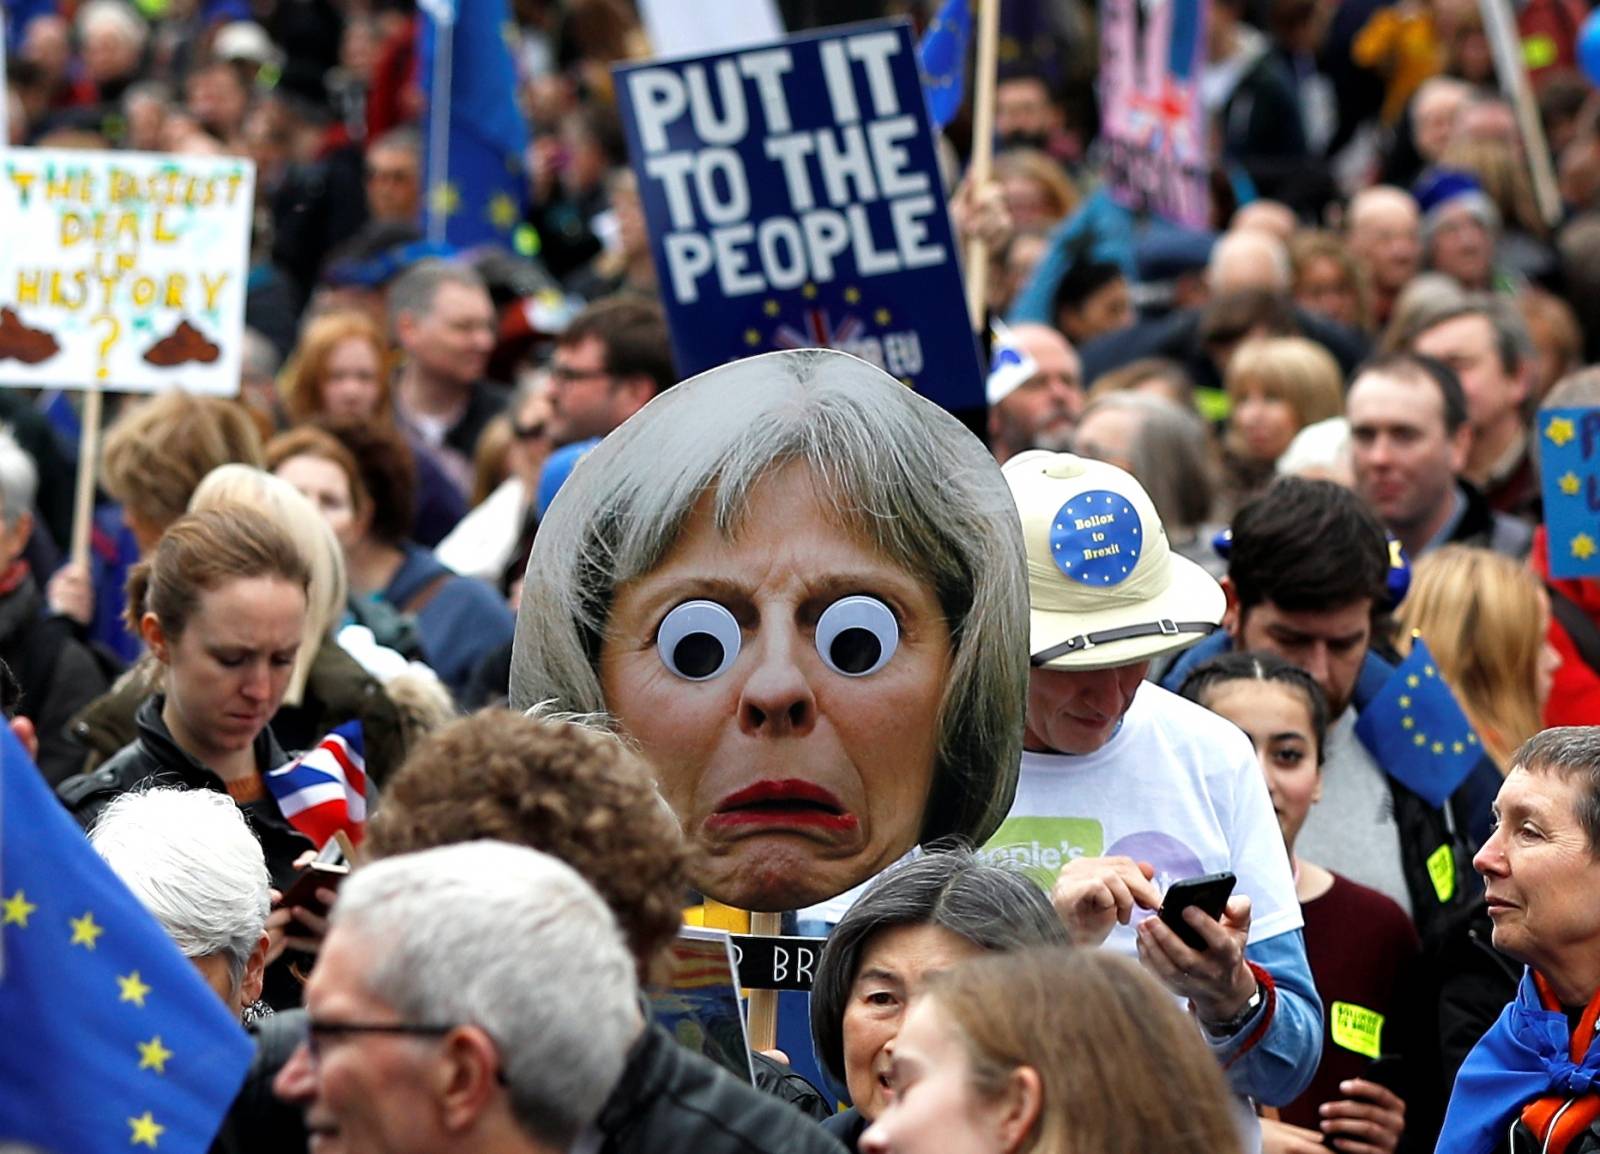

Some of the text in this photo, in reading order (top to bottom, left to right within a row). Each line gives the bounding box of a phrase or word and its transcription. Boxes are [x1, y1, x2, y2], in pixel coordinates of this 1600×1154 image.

[627, 30, 902, 154] PUT IT
[8, 163, 94, 207] THE
[645, 115, 931, 229] TO THE
[59, 211, 178, 247] DEAL
[662, 195, 948, 304] PEOPLE
[94, 251, 137, 275] IN
[16, 269, 229, 310] HISTORY
[90, 313, 121, 379] ?
[1074, 513, 1115, 530] Bollox
[1092, 532, 1105, 542] to
[1083, 544, 1120, 560] Brexit
